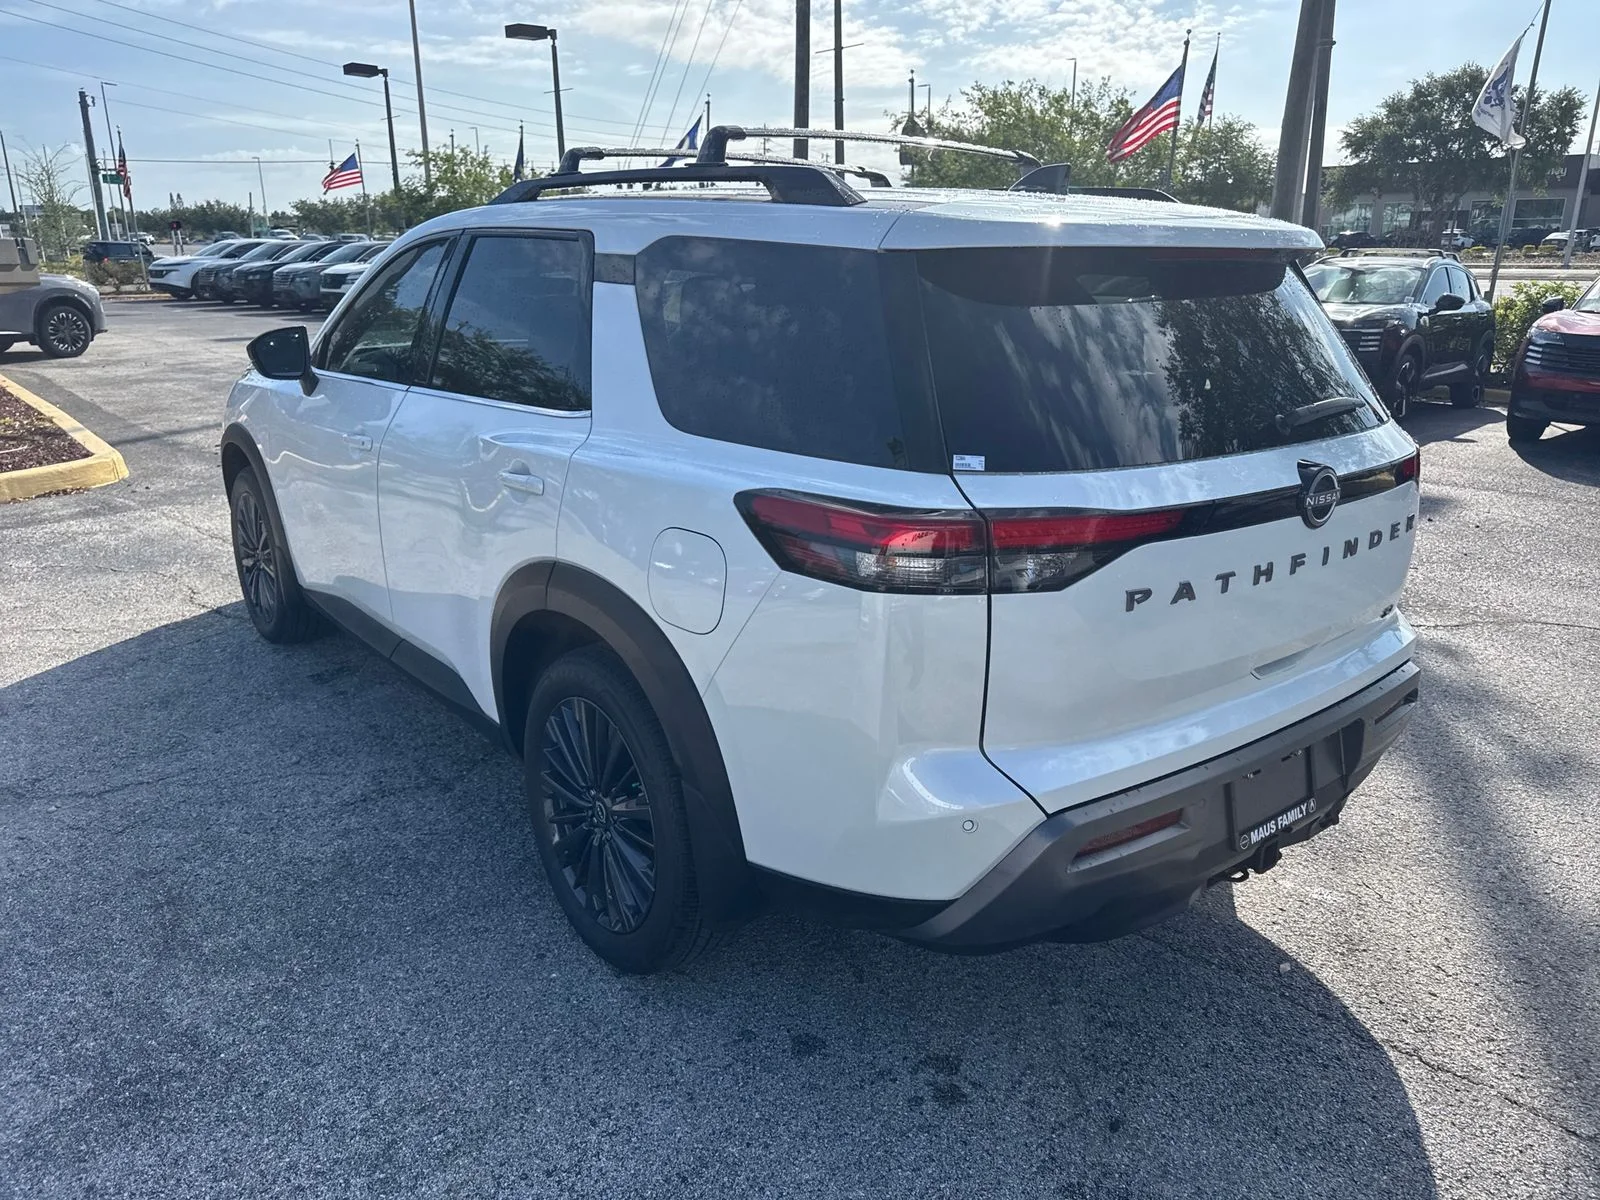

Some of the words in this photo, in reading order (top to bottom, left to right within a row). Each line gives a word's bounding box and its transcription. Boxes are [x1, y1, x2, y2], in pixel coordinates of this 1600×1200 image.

[1125, 513, 1416, 612] PATHFINDER
[1250, 820, 1277, 844] MAUS
[1277, 802, 1308, 830] FAMILY
